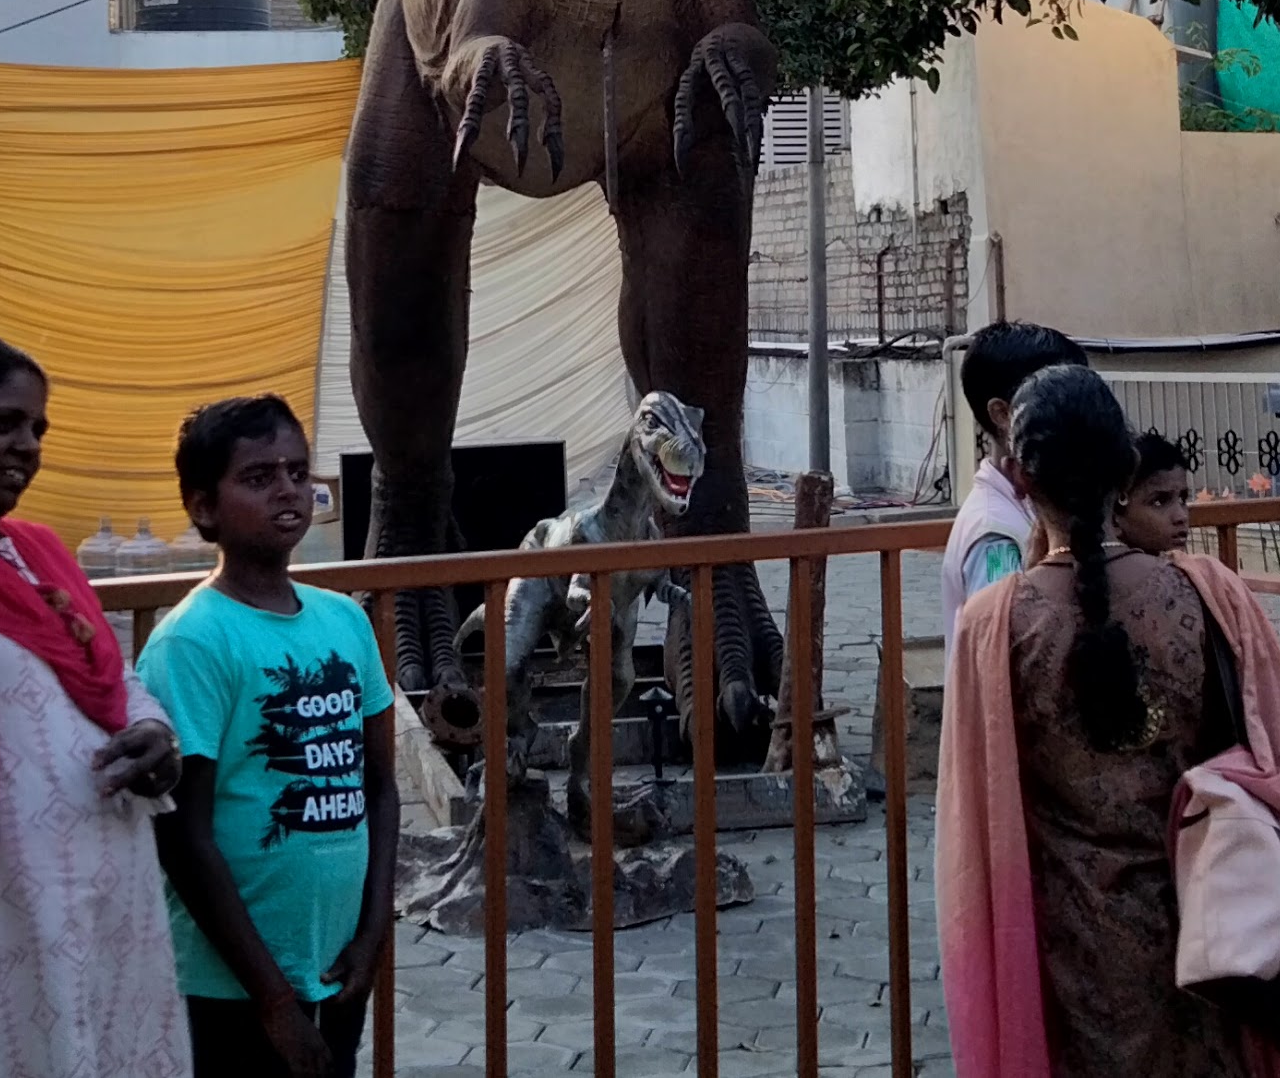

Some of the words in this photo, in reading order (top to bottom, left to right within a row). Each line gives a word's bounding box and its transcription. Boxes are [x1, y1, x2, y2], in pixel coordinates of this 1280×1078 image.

[297, 689, 354, 718] GOOD
[305, 739, 355, 770] DAYS
[302, 790, 365, 822] AHEAD
